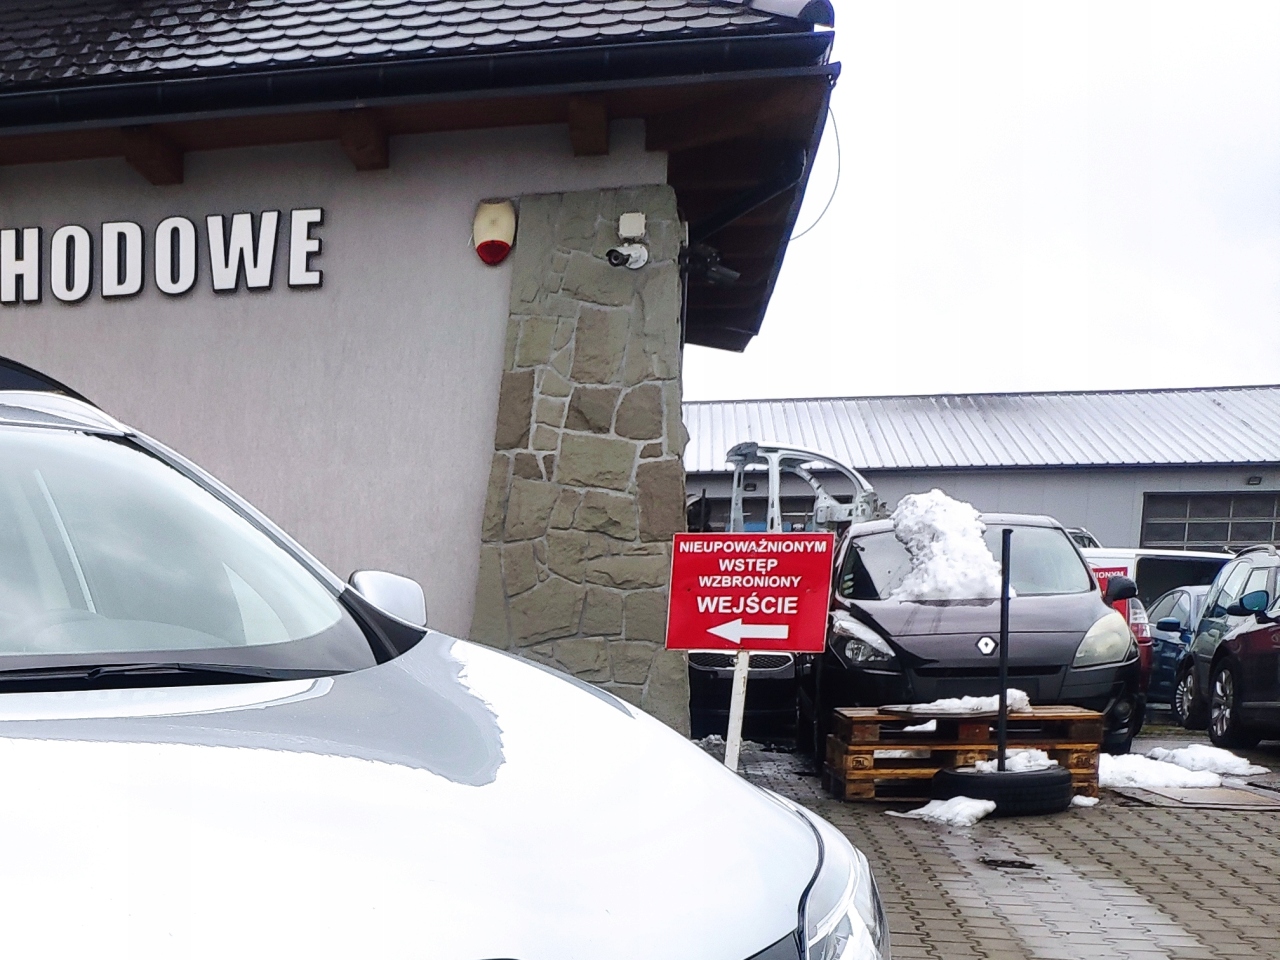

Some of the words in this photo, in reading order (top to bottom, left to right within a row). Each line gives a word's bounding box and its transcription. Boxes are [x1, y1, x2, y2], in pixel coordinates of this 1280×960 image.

[679, 539, 827, 553] NIEUPOWAŻNIONYM
[719, 558, 778, 575] WSTĘP
[699, 575, 802, 588] WZBRONIONY
[697, 592, 799, 614] WEJŚCIE
